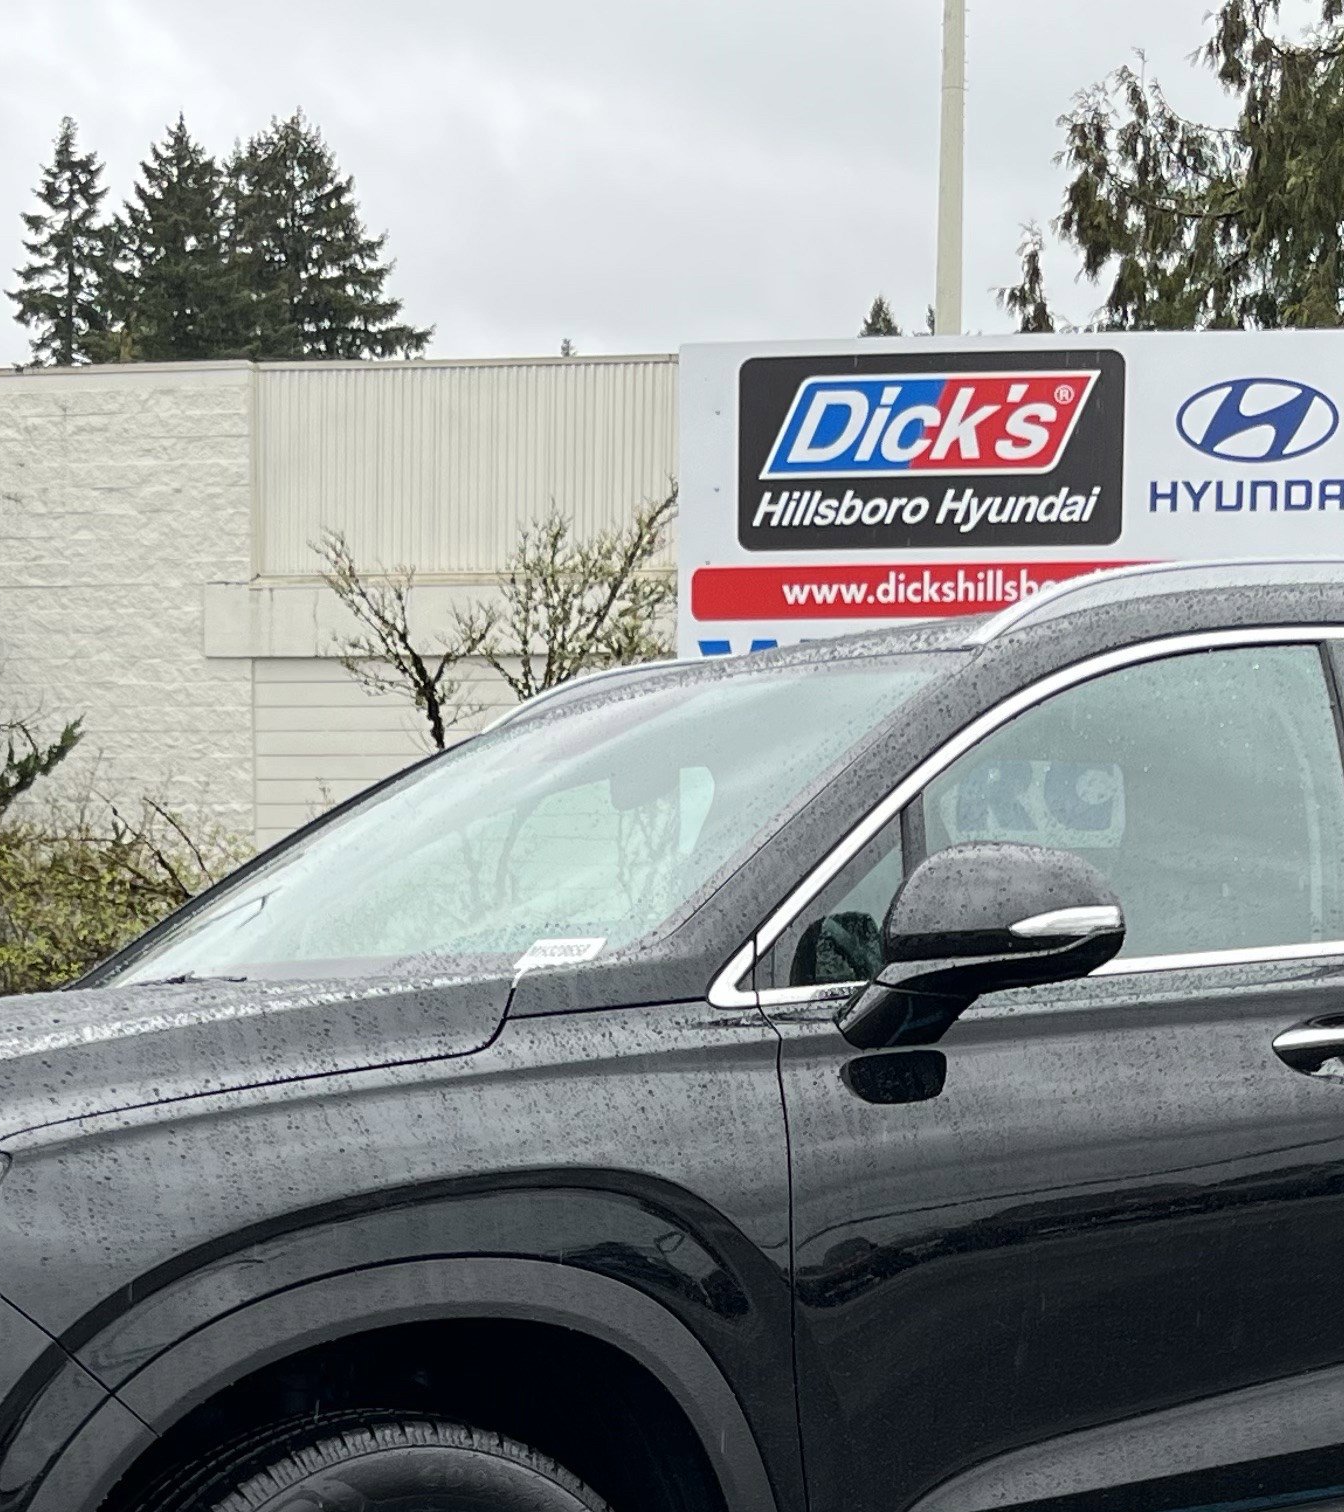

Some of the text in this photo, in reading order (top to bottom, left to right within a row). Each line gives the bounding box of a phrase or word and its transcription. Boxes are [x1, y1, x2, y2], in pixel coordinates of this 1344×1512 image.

[786, 384, 1057, 464] Dick's
[752, 486, 1101, 533] Hillsboro Hyundai
